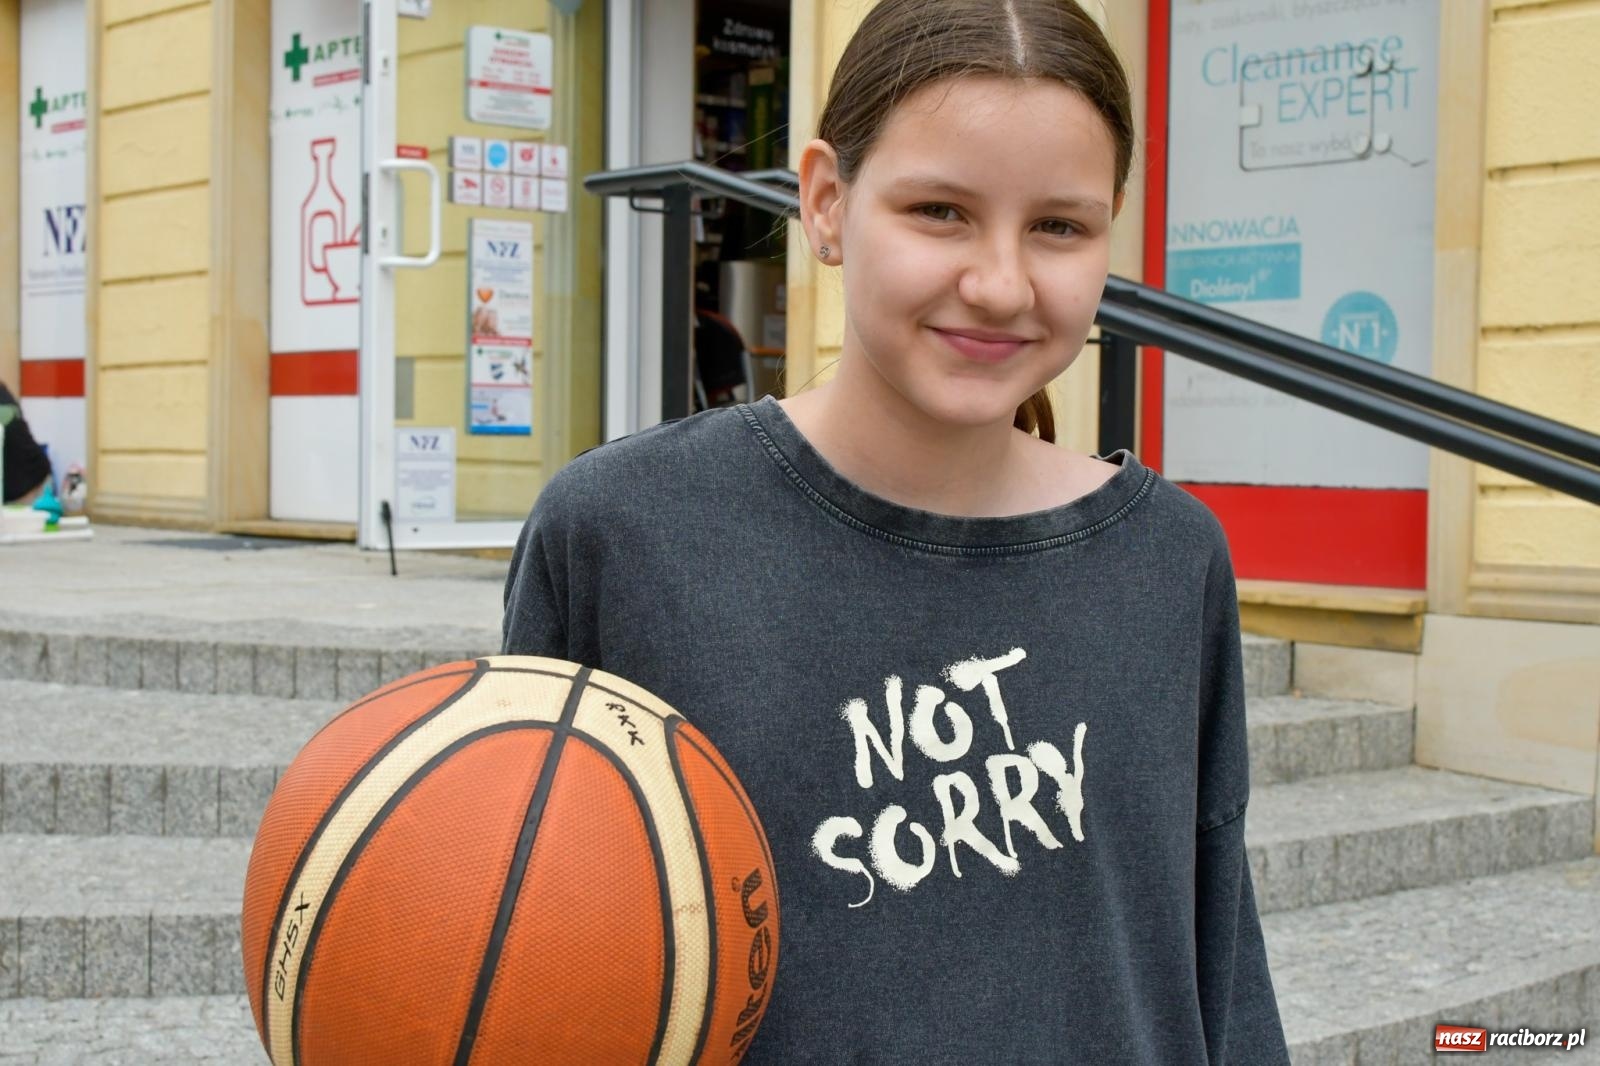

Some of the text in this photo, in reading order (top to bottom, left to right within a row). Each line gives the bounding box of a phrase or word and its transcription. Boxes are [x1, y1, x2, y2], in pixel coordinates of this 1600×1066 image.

[1202, 34, 1405, 87] Cleanance
[1277, 68, 1419, 123] EXPERT
[838, 646, 1027, 789] NOT
[809, 722, 1087, 908] SORRY
